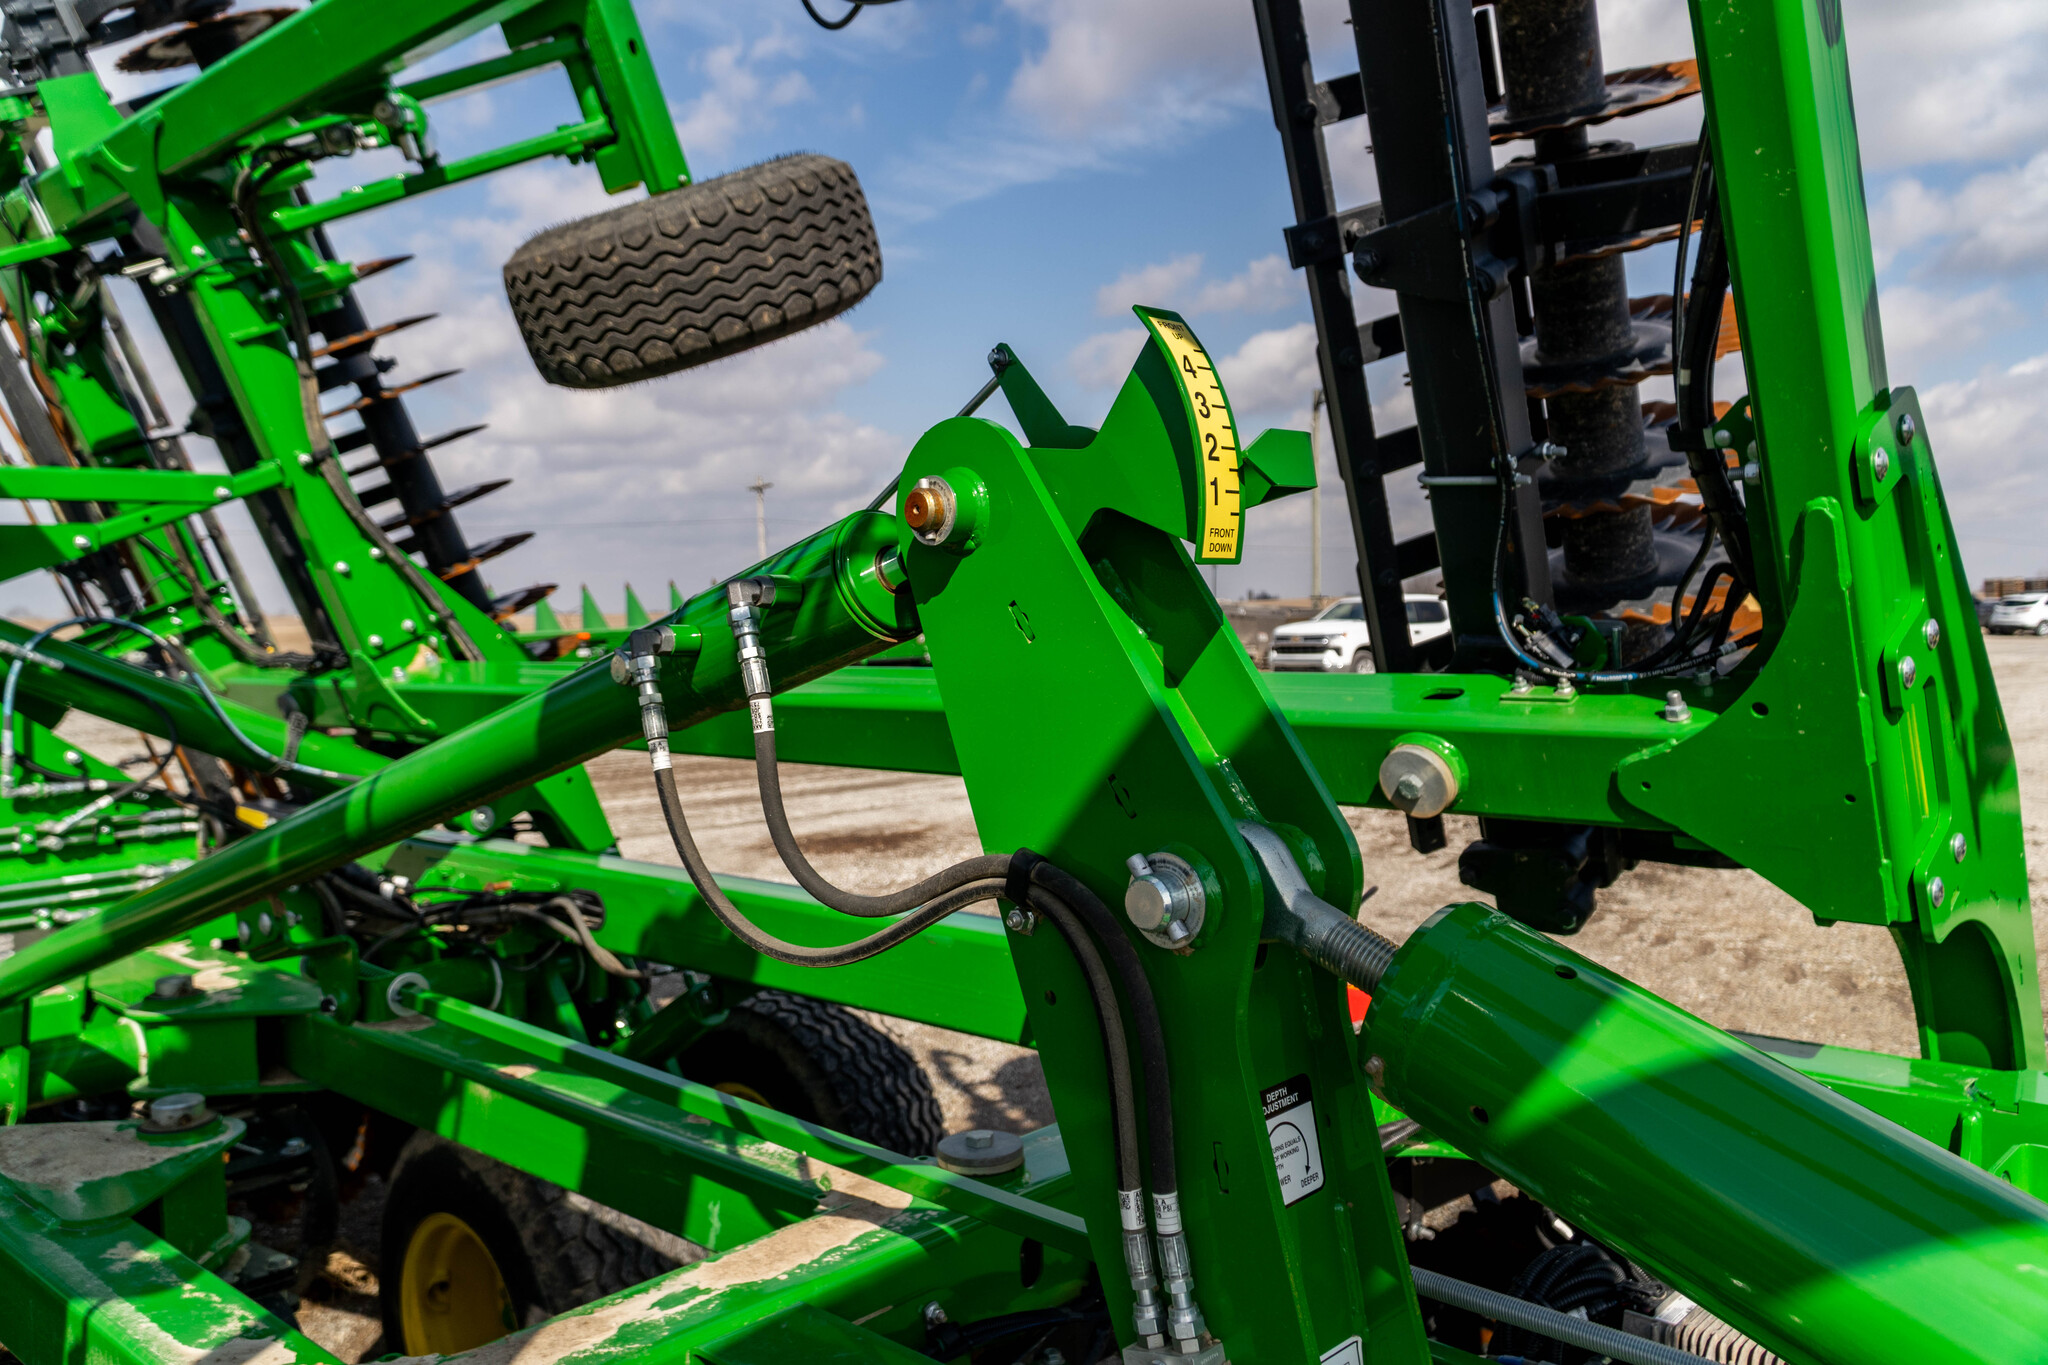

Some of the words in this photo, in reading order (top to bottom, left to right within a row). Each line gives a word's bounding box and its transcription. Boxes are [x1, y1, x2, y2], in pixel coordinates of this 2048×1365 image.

[1157, 320, 1184, 332] FRONT
[1171, 332, 1184, 340] UP
[1183, 354, 1198, 379] 4
[1195, 391, 1211, 419] 3
[1205, 432, 1220, 462] 2
[1210, 476, 1219, 506] 1
[1209, 528, 1235, 539] FRONT
[1209, 542, 1233, 553] DOWN
[1266, 1086, 1288, 1103] DEPTH
[1262, 1092, 1299, 1116] DJUSTMENT
[1272, 1143, 1285, 1154] URNS
[1284, 1135, 1301, 1148] EQUALS
[1280, 1146, 1300, 1160] WORKING
[1300, 1172, 1320, 1188] DEEPER
